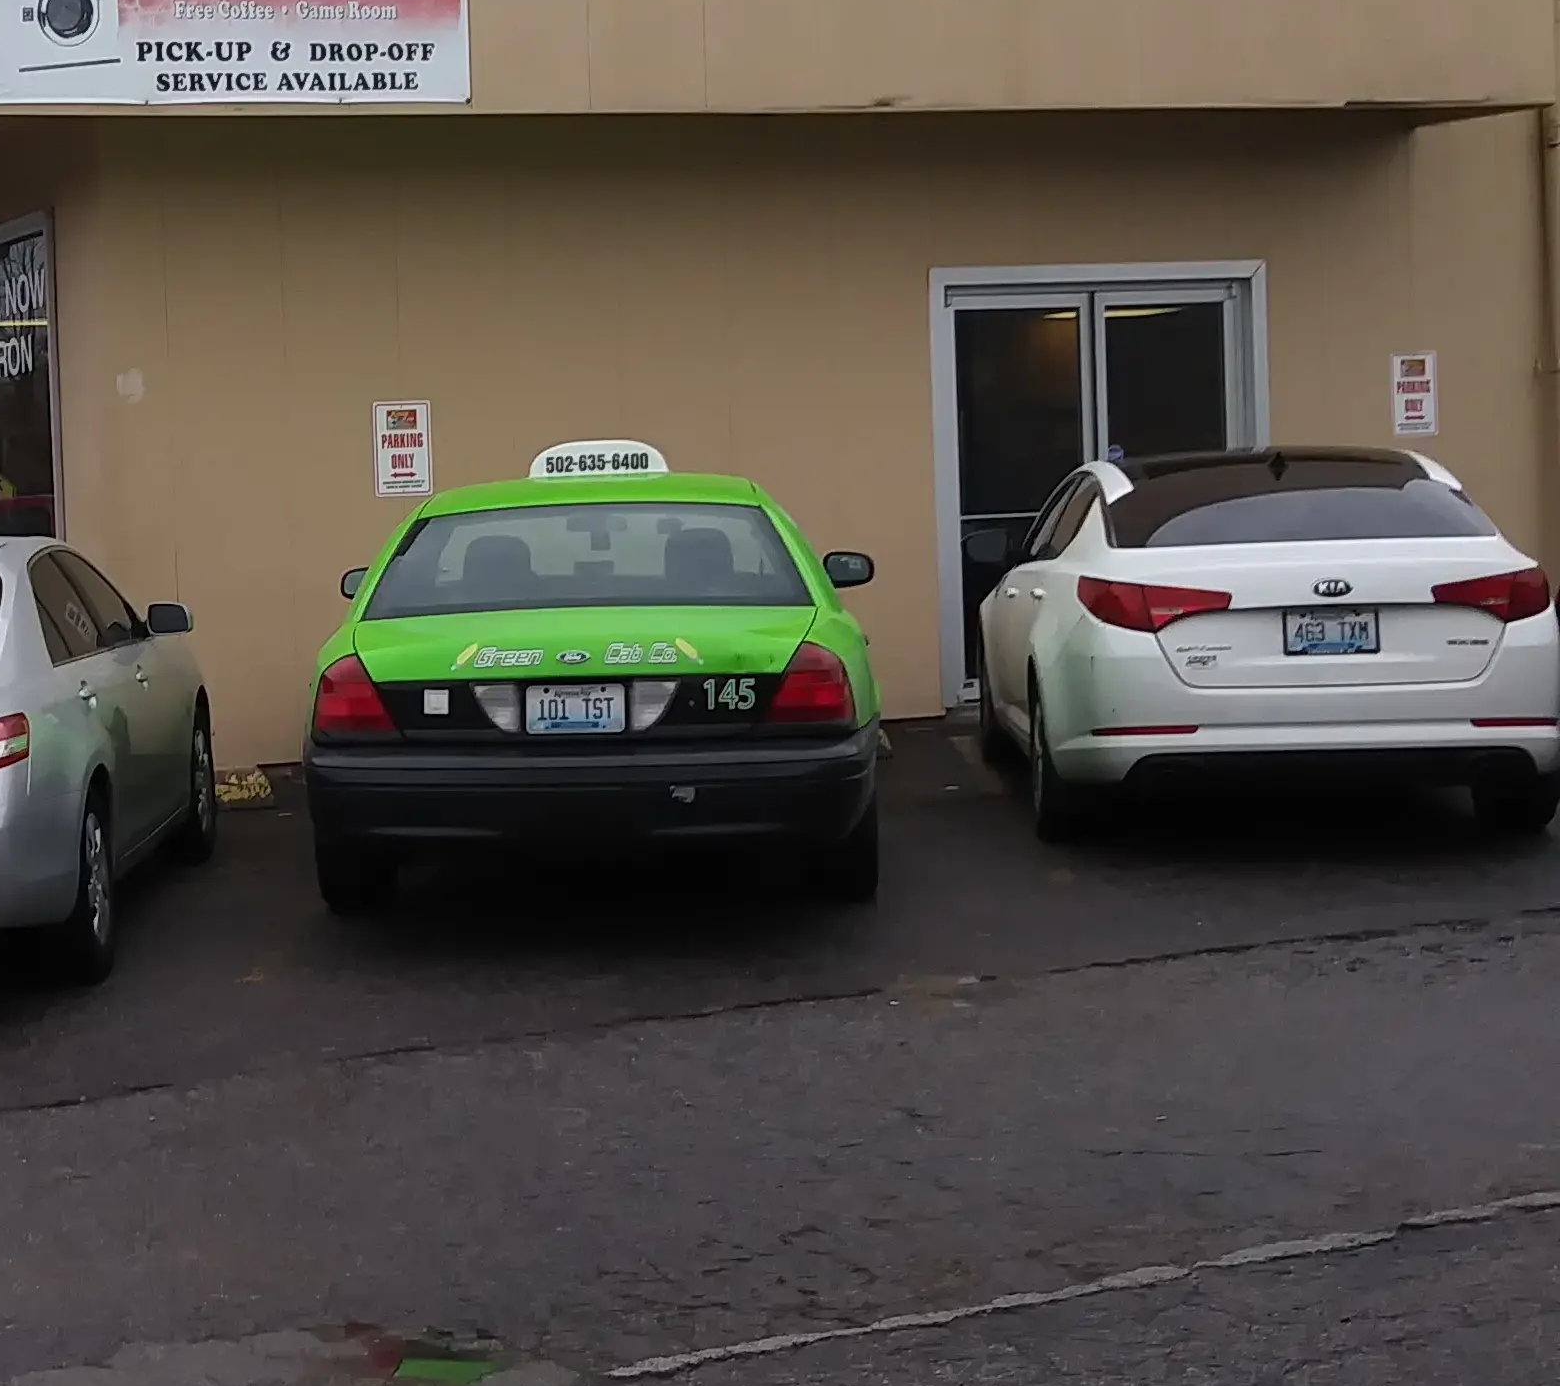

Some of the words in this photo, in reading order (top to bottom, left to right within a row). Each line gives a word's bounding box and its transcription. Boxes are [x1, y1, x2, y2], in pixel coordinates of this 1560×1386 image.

[174, 0, 215, 20] Free
[218, 0, 274, 20] Coffee
[295, 0, 344, 20] Game
[347, 0, 397, 20] Room
[136, 41, 252, 62] PICK-UP
[270, 41, 291, 61] &
[309, 43, 435, 62] DROP-OFF
[156, 72, 268, 92] SERVICE
[276, 71, 419, 91] AVAILABLE
[5, 268, 45, 316] NOW
[381, 433, 423, 449] PARKING
[391, 453, 415, 469] ONLY
[545, 452, 649, 473] 502-635-6400
[1318, 581, 1347, 594] KIA
[473, 646, 544, 668] Green
[604, 642, 643, 664] Cab
[703, 677, 756, 710] 145
[537, 698, 569, 721] 101
[582, 697, 614, 720] TST
